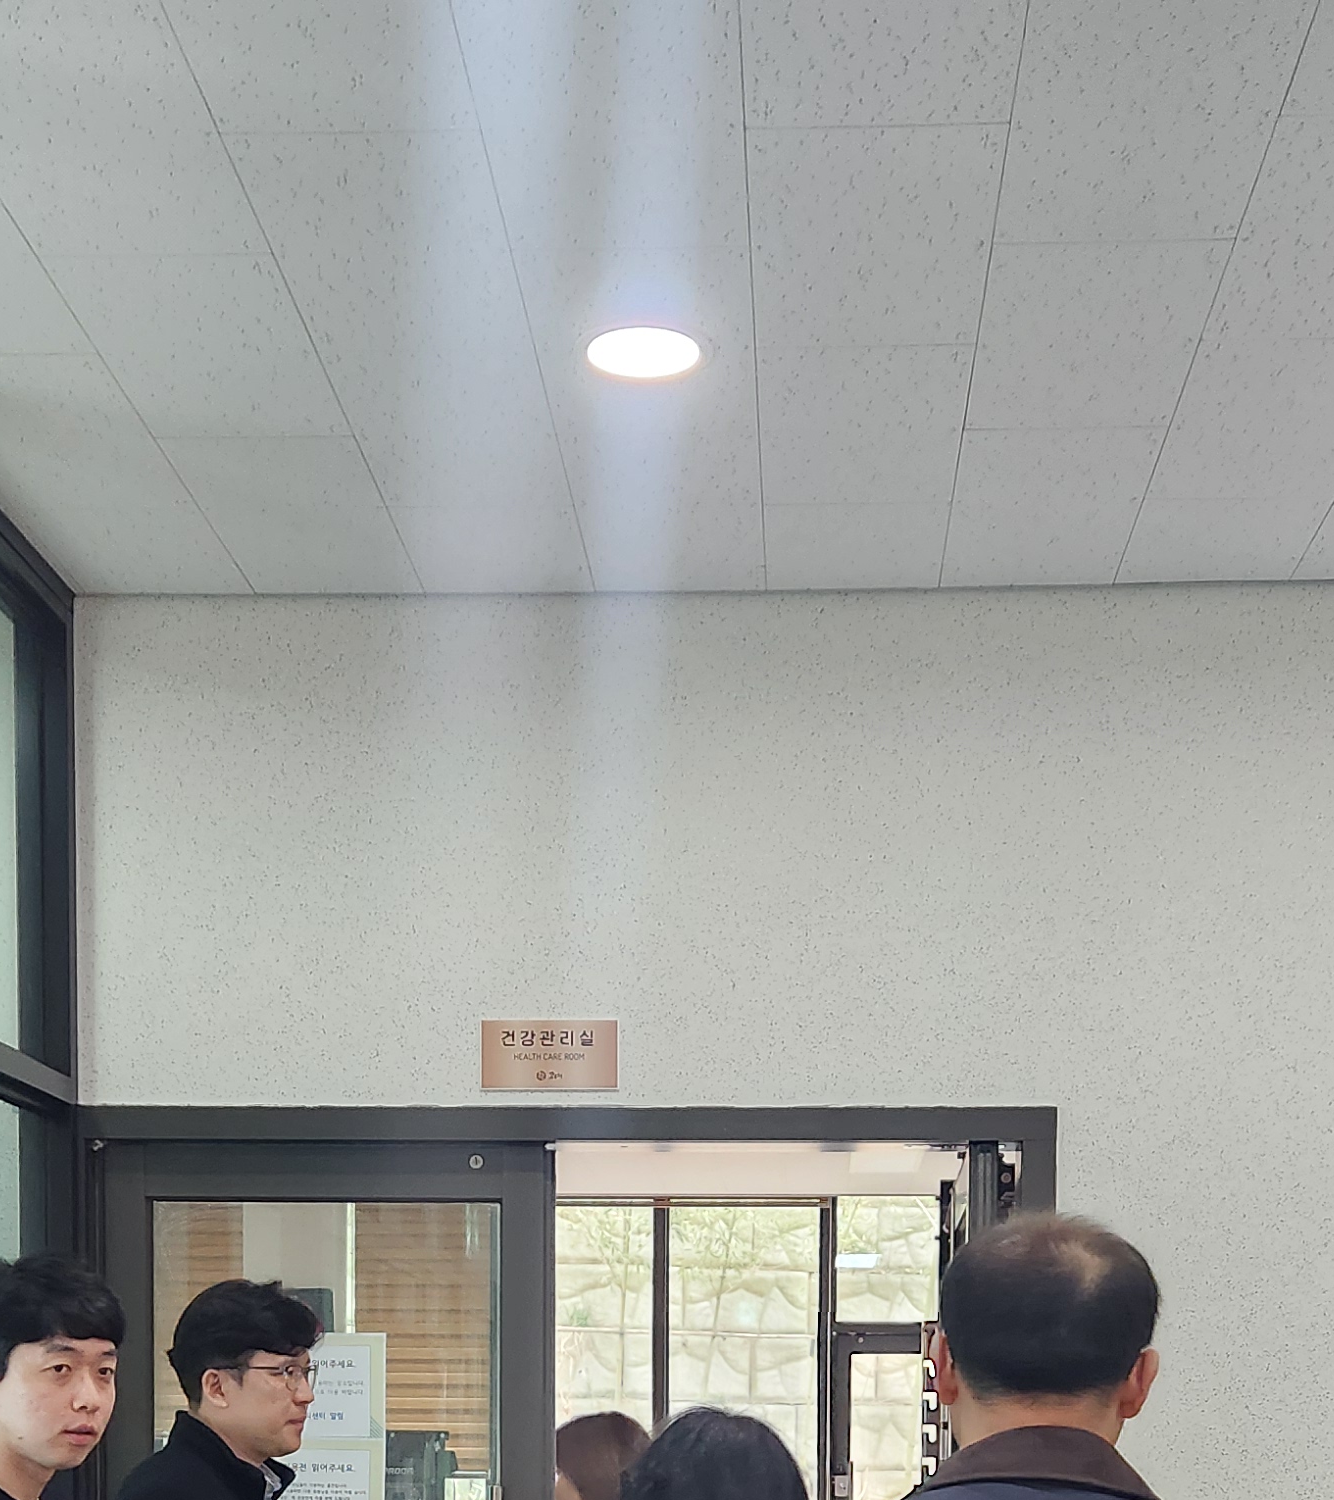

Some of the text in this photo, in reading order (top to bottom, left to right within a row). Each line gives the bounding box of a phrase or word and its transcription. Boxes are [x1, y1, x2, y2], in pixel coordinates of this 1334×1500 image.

[500, 1030, 595, 1047] 건강관리실
[513, 1052, 585, 1061] HEALTH CARE ROOM
